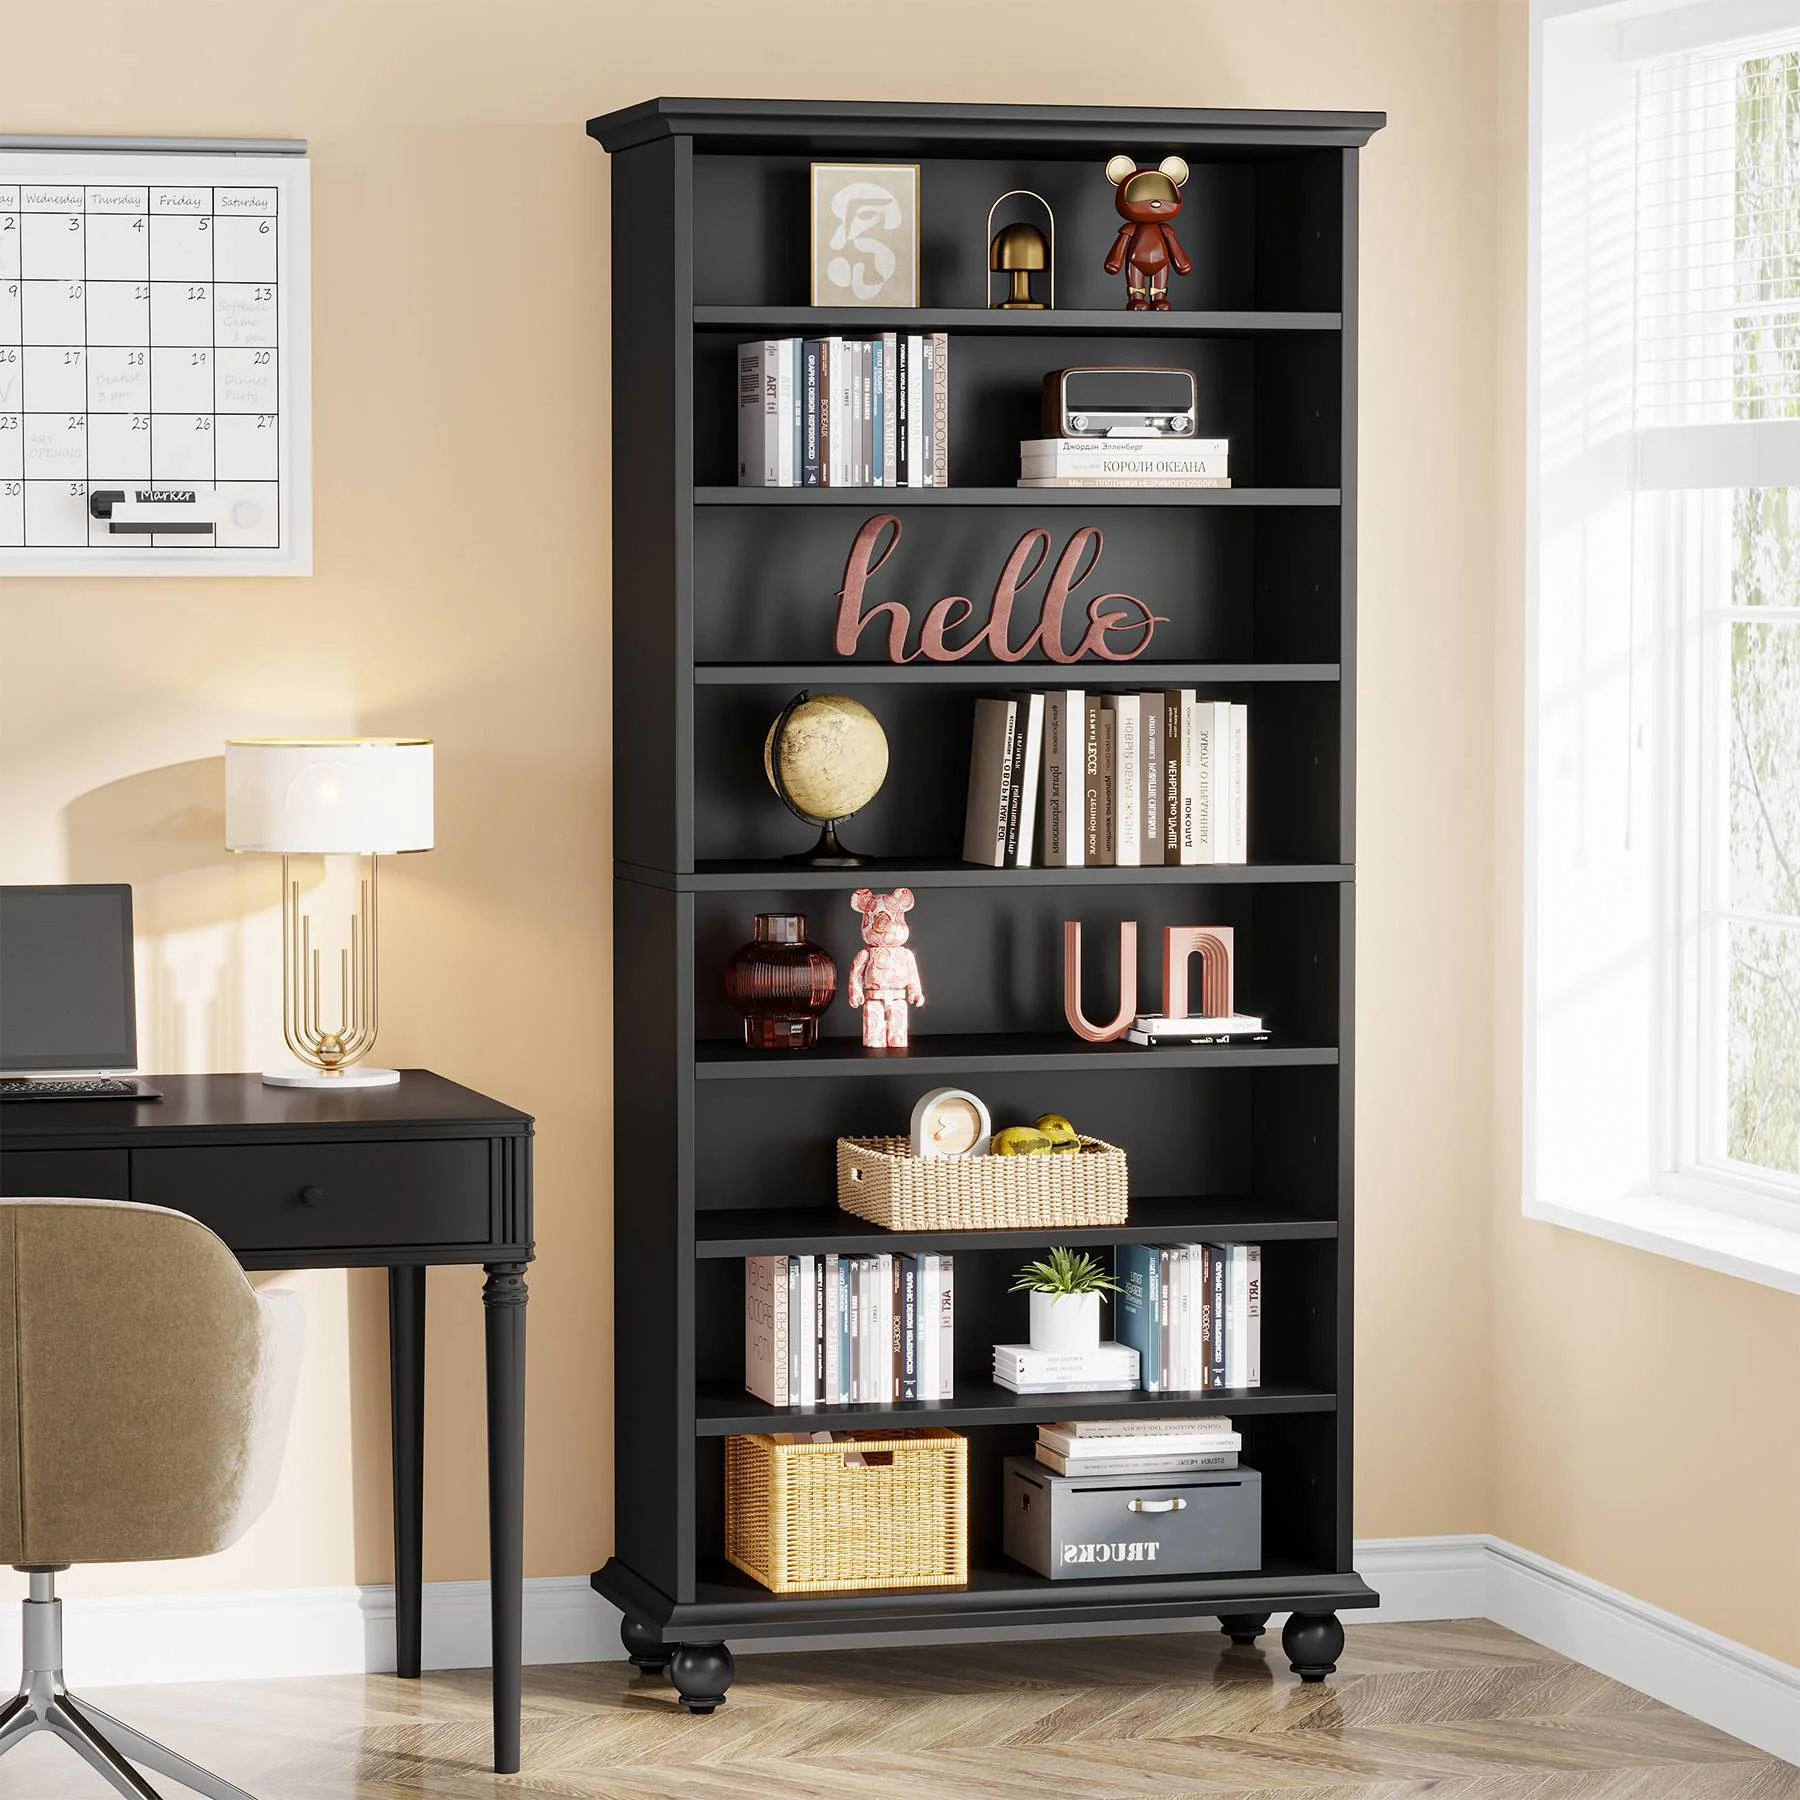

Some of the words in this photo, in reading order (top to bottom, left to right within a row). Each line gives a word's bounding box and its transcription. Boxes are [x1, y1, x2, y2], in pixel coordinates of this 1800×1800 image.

[26, 193, 83, 207] Wednesday
[92, 194, 141, 208] Thursday
[159, 194, 201, 209] Friday
[221, 196, 269, 209] Saturday
[4, 216, 16, 231] 2
[69, 218, 80, 231] 3
[133, 218, 144, 232] 4
[198, 217, 210, 231] 5
[258, 220, 270, 234] 6
[8, 284, 18, 298] 9
[68, 285, 83, 299] 10
[134, 287, 150, 300] 11
[187, 287, 206, 301] 12
[254, 287, 273, 301] 13
[64, 352, 80, 364] 17
[128, 352, 144, 366] 18
[191, 352, 207, 366] 19
[254, 351, 271, 365] 20
[935, 337, 946, 387] ALEXEY
[96, 373, 141, 386] Dentist
[224, 374, 270, 386] Dinner
[766, 375, 776, 398] ART
[885, 369, 894, 401] BOOK
[225, 390, 259, 404] Party
[0, 416, 18, 430] 23
[68, 416, 84, 430] 24
[132, 417, 150, 431] 25
[195, 417, 211, 431] 26
[257, 415, 275, 430] 27
[885, 412, 894, 467] SYMBOLS
[935, 393, 946, 478] BRODOVITCH
[1062, 442, 1099, 452] Джордан
[1101, 442, 1143, 451] Элленберг
[1103, 461, 1154, 473] КОРОЛИ
[1156, 461, 1206, 473] ОКЕАНА
[4, 483, 20, 496] 30
[70, 483, 86, 496] 31
[140, 490, 193, 502] Marker
[833, 513, 1171, 664] hello
